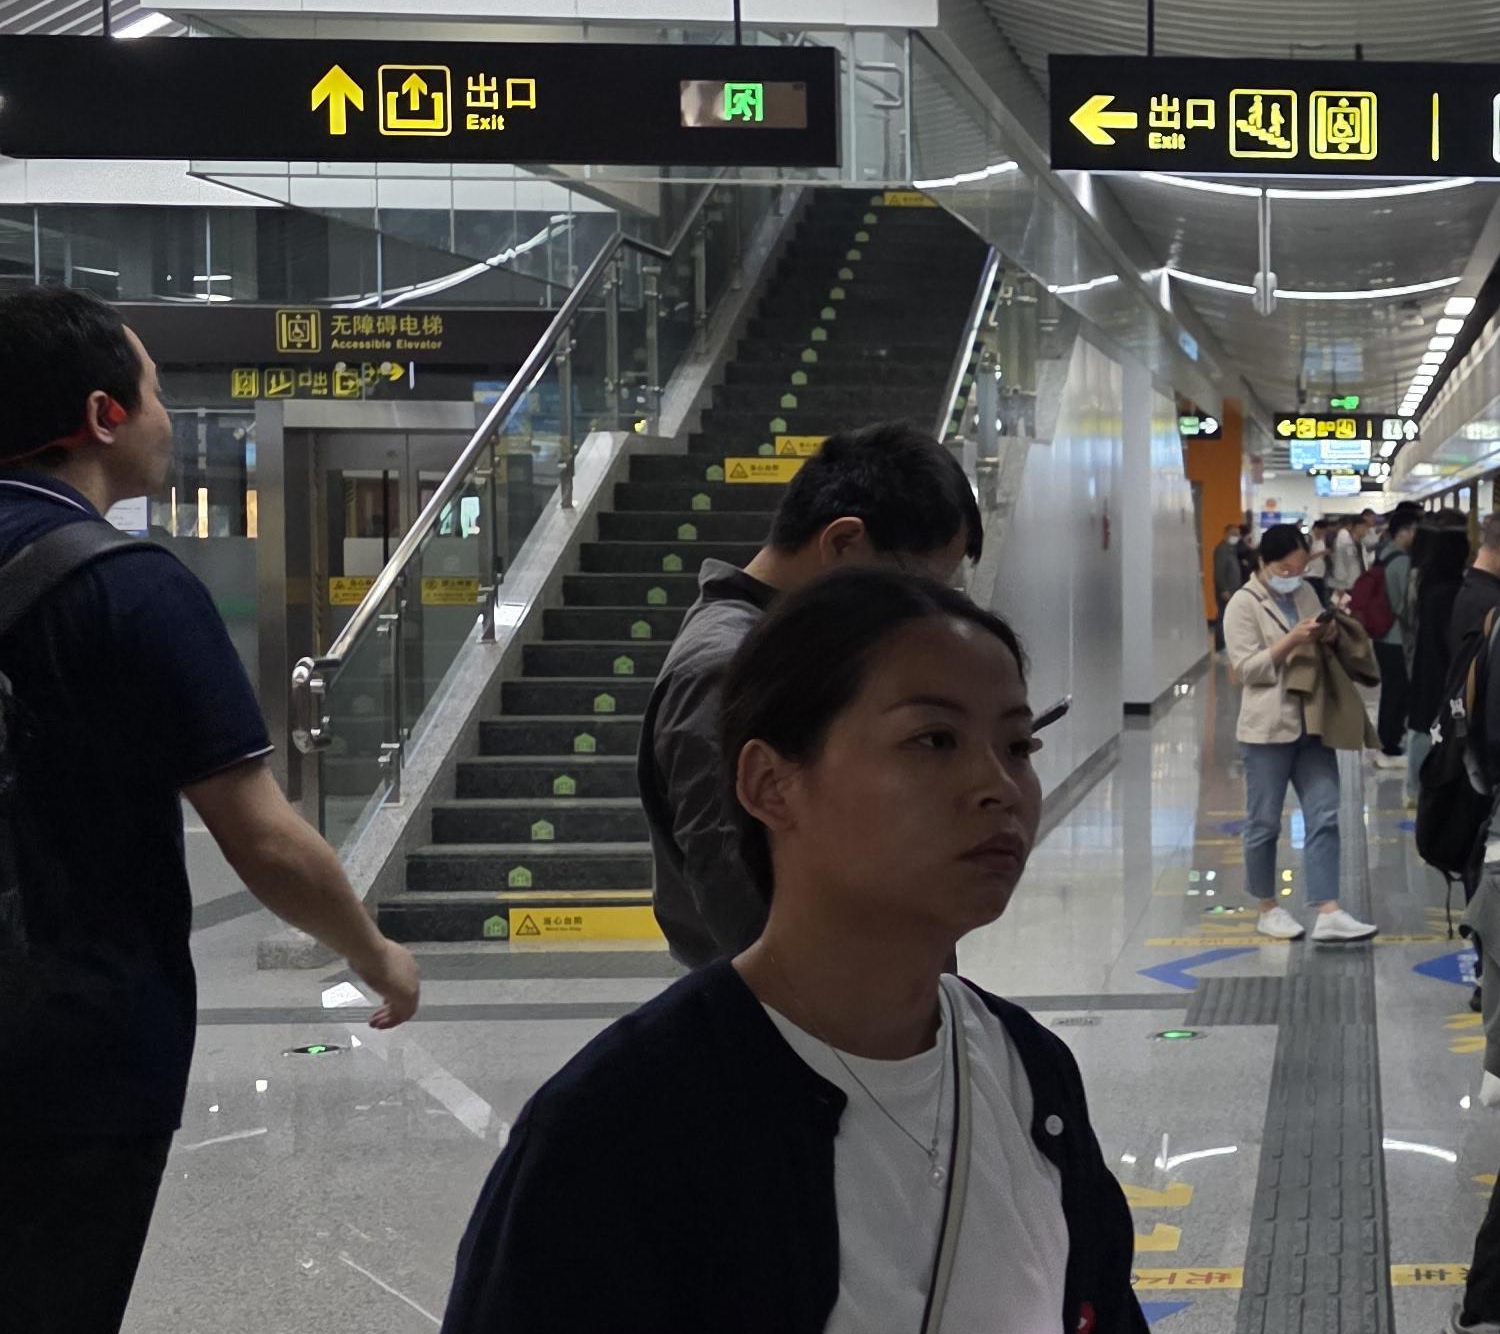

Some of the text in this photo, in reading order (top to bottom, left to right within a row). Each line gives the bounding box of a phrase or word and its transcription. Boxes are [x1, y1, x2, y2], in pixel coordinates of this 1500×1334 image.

[466, 73, 537, 110] 出口
[466, 113, 506, 132] Exit
[1148, 93, 1215, 131] 出口
[1148, 131, 1186, 149] Exit
[330, 314, 443, 337] 无障碍电梯
[331, 339, 442, 350] Accessible Elevator
